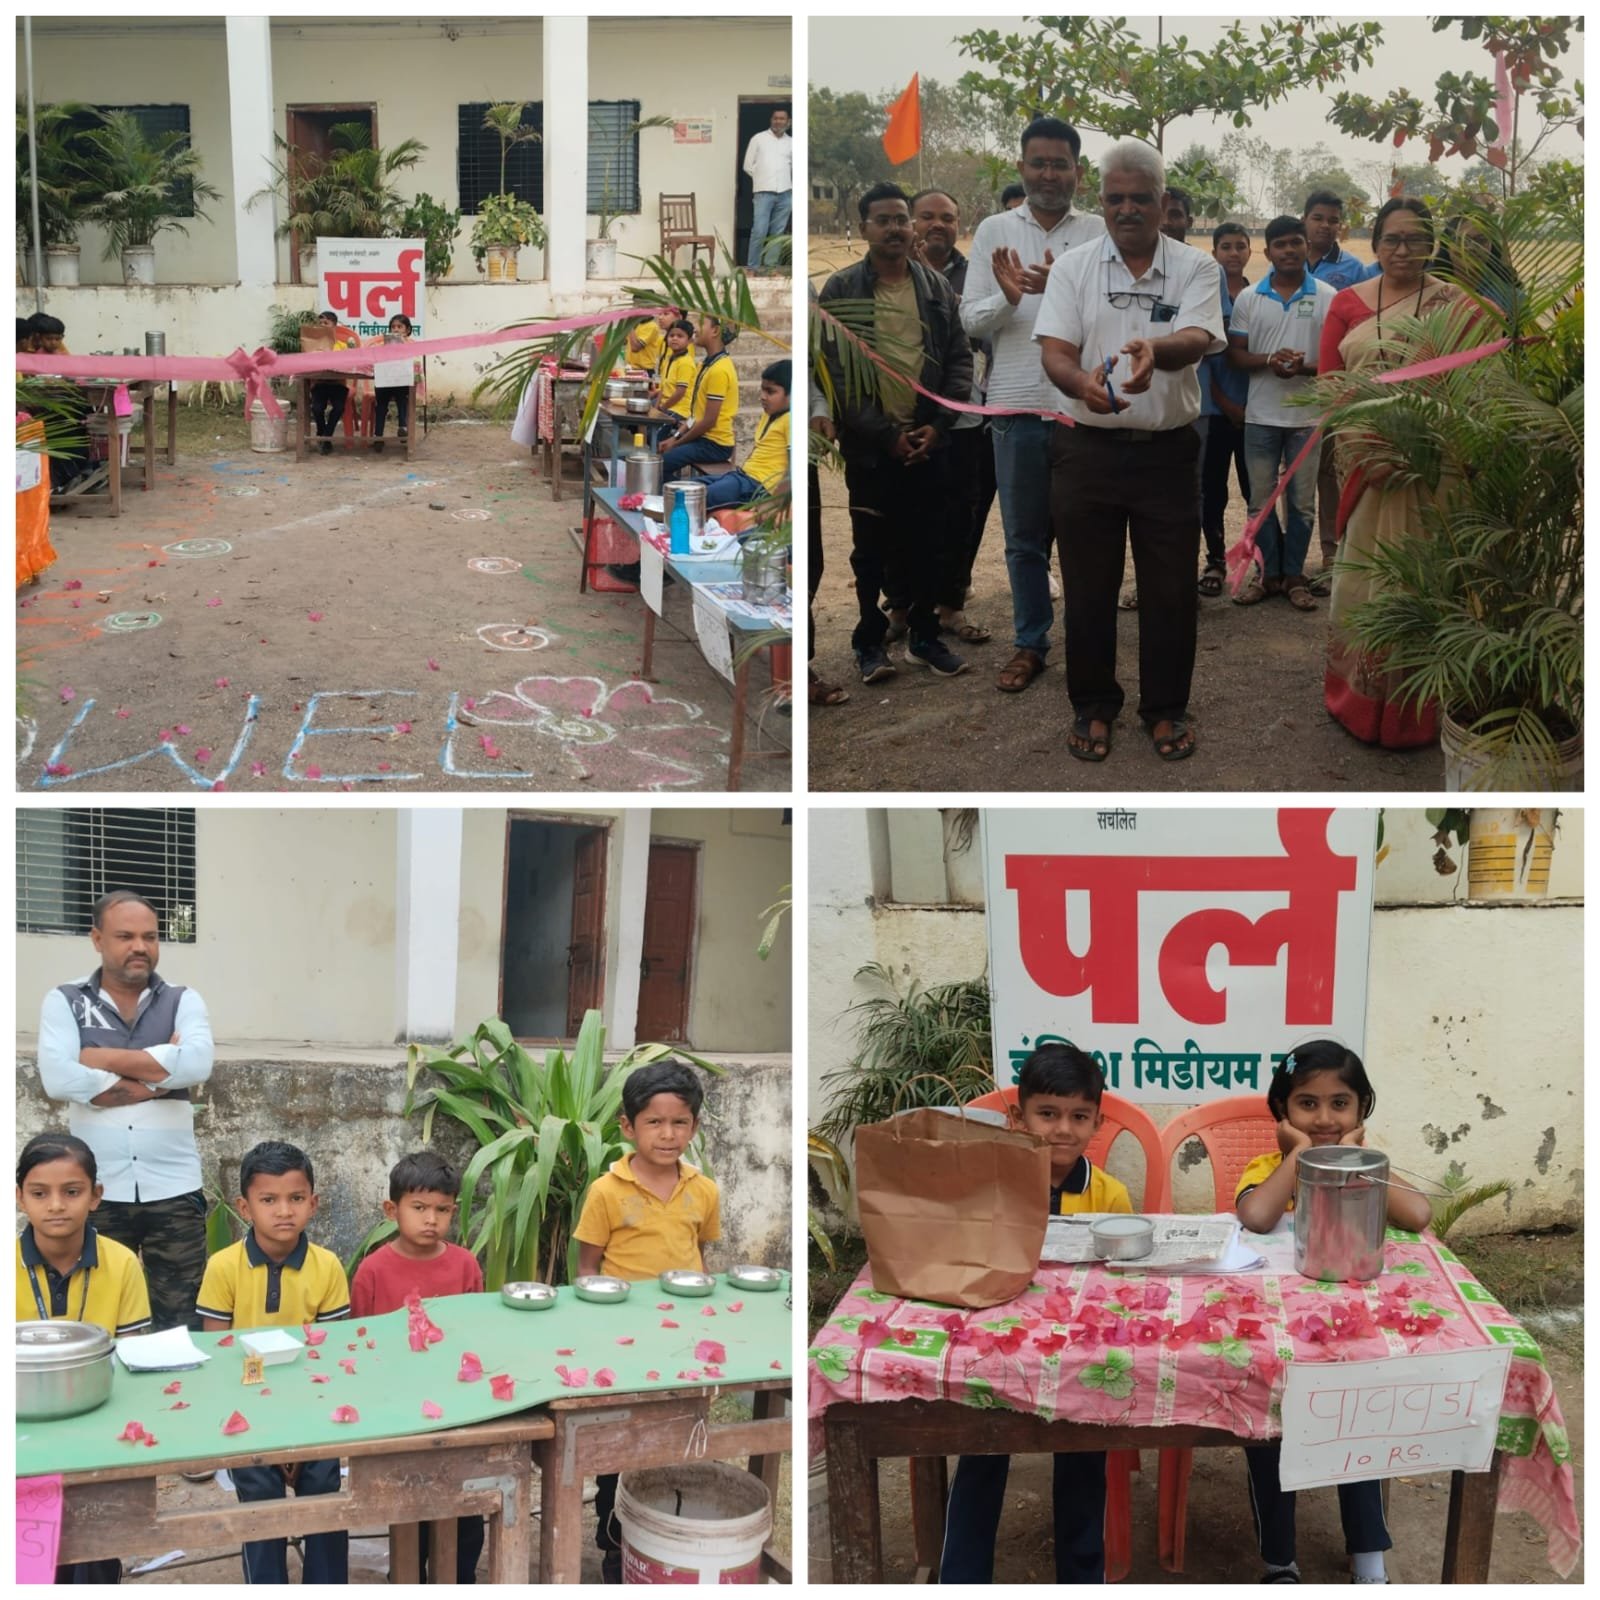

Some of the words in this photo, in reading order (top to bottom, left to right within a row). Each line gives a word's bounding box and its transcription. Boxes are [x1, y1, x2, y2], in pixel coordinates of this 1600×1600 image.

[324, 249, 423, 318] पर्ल
[1005, 808, 1358, 1026] पर्ल
[1132, 1038, 1261, 1090] मिडीयम
[1344, 1451, 1371, 1472] 10
